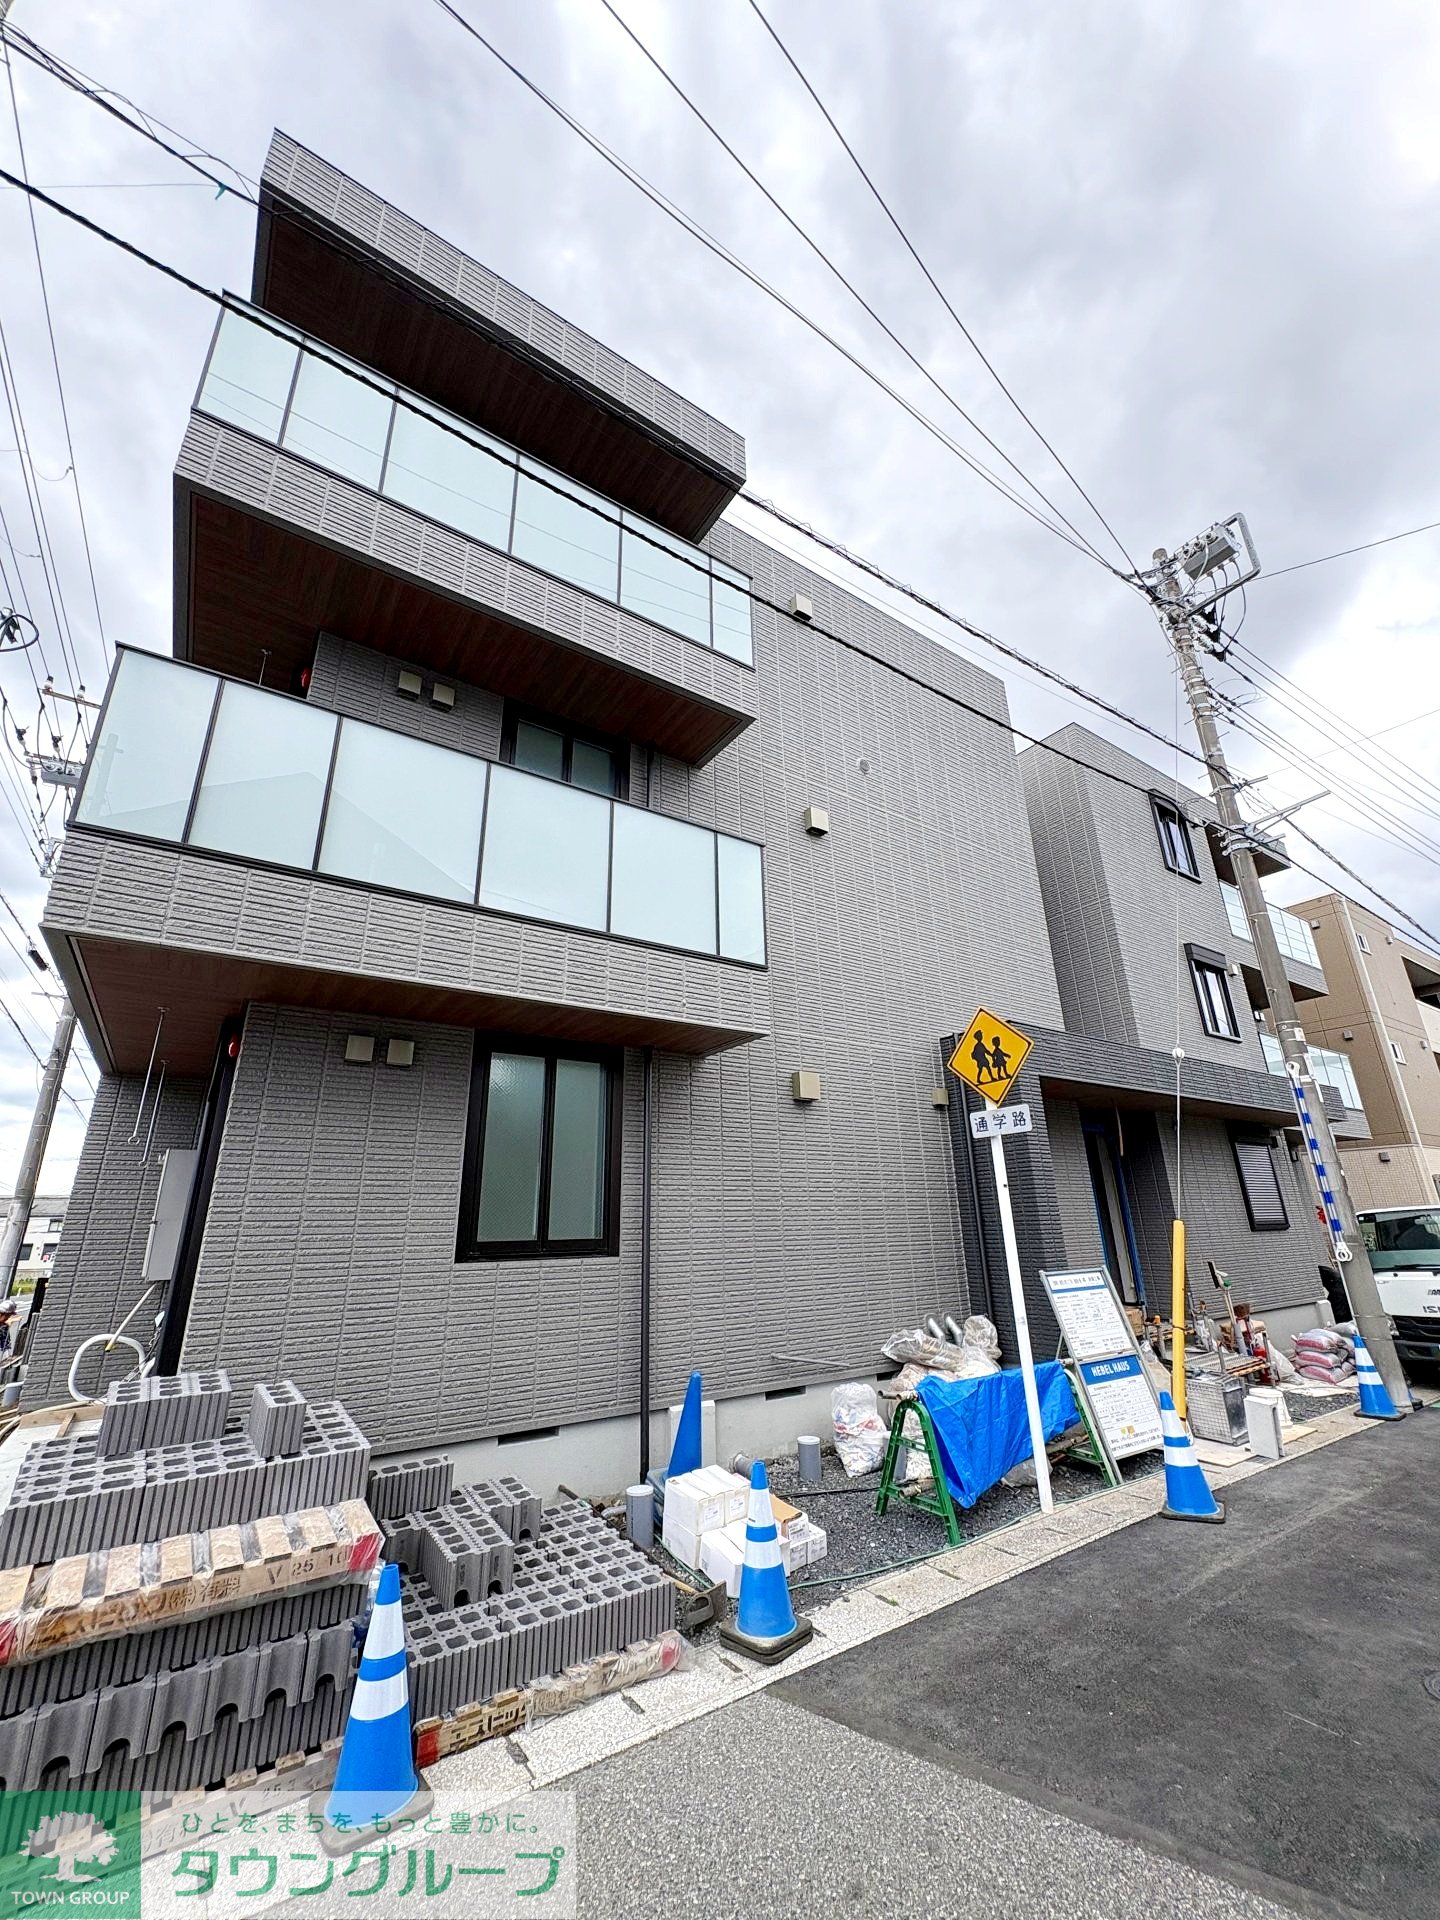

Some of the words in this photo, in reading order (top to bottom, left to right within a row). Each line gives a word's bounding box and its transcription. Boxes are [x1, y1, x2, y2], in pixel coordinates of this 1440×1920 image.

[975, 1111, 1026, 1133] 通学路
[1422, 1305, 1440, 1314] IS
[1091, 1364, 1114, 1377] HEBEL
[1112, 1361, 1130, 1373] HAUS
